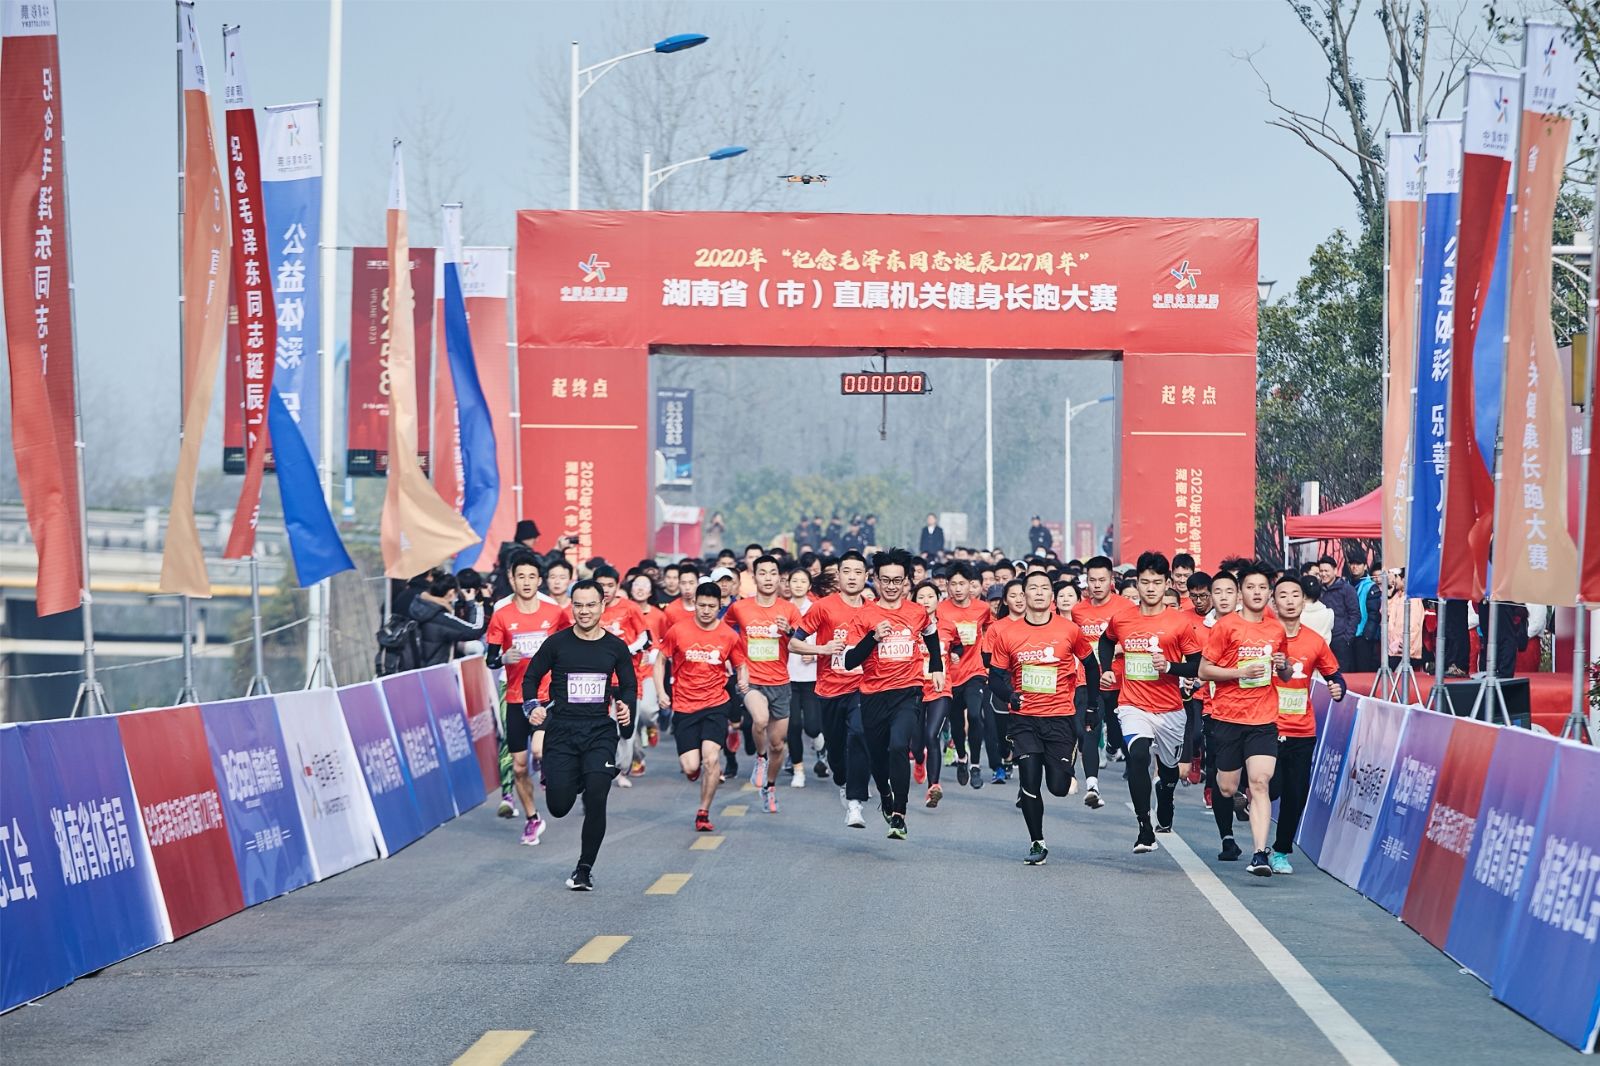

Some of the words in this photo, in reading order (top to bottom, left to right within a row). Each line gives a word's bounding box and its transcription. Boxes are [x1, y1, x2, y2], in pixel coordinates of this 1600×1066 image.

[661, 278, 1118, 313] 湖南省（市）直属机关健身长跑大赛
[551, 378, 608, 399] 起终点
[844, 375, 922, 393] 000000
[1161, 385, 1217, 405] 起终点
[880, 643, 910, 656] A1300
[1124, 638, 1149, 649] 2020
[569, 683, 602, 695] D1031
[1023, 673, 1052, 687] C1073
[50, 797, 135, 886] 湖南省体育局
[1472, 806, 1535, 902] 湖南省体育局
